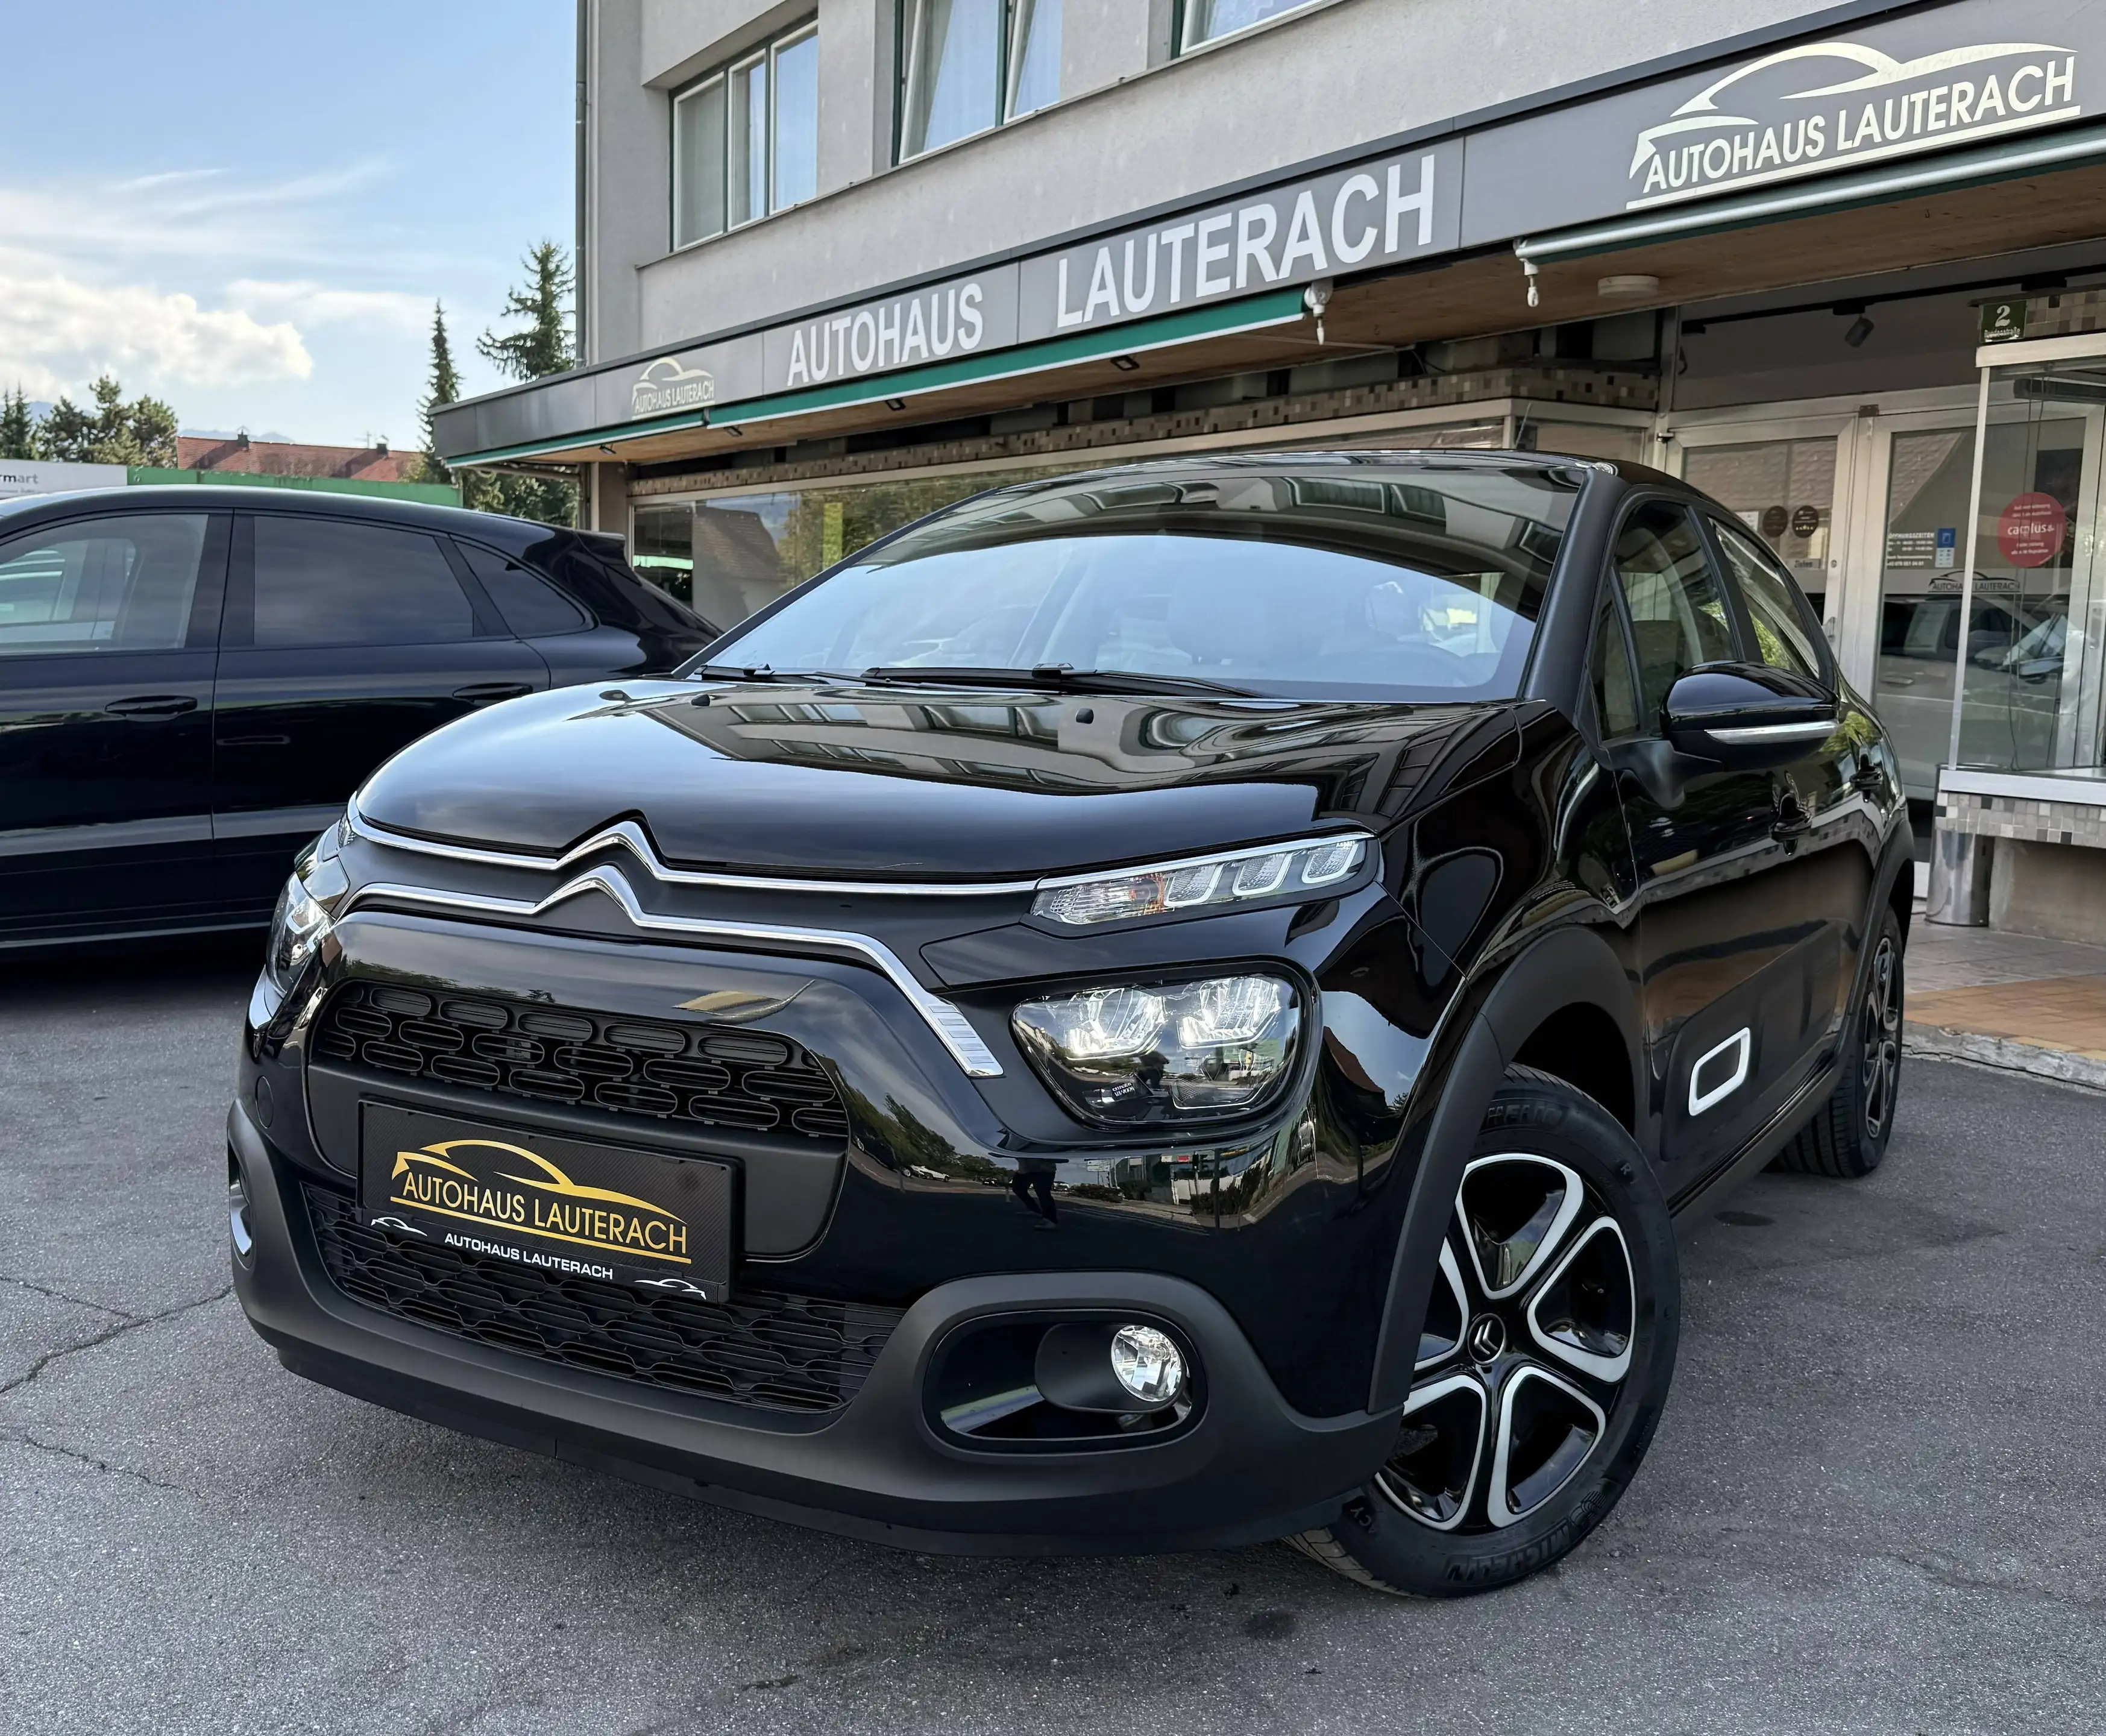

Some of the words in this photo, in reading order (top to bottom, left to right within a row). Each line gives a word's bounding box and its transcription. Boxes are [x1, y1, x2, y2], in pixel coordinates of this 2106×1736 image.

[1643, 115, 1825, 193] AUTOHAUS
[1837, 56, 2075, 151] LAUTERACH
[787, 283, 984, 386] AUTOHAUS
[1057, 154, 1435, 329] LAUTERACH
[1995, 305, 2010, 327] 2
[635, 388, 671, 413] AUTOHAUS
[672, 379, 714, 406] LAUTERACH
[1932, 582, 1964, 591] AUTOHA
[403, 1172, 525, 1222] AUTOHAUS
[535, 1199, 687, 1254] LAUTERACH
[444, 1233, 520, 1259] AUTOHAUS
[523, 1251, 613, 1280] LAUTERACH
